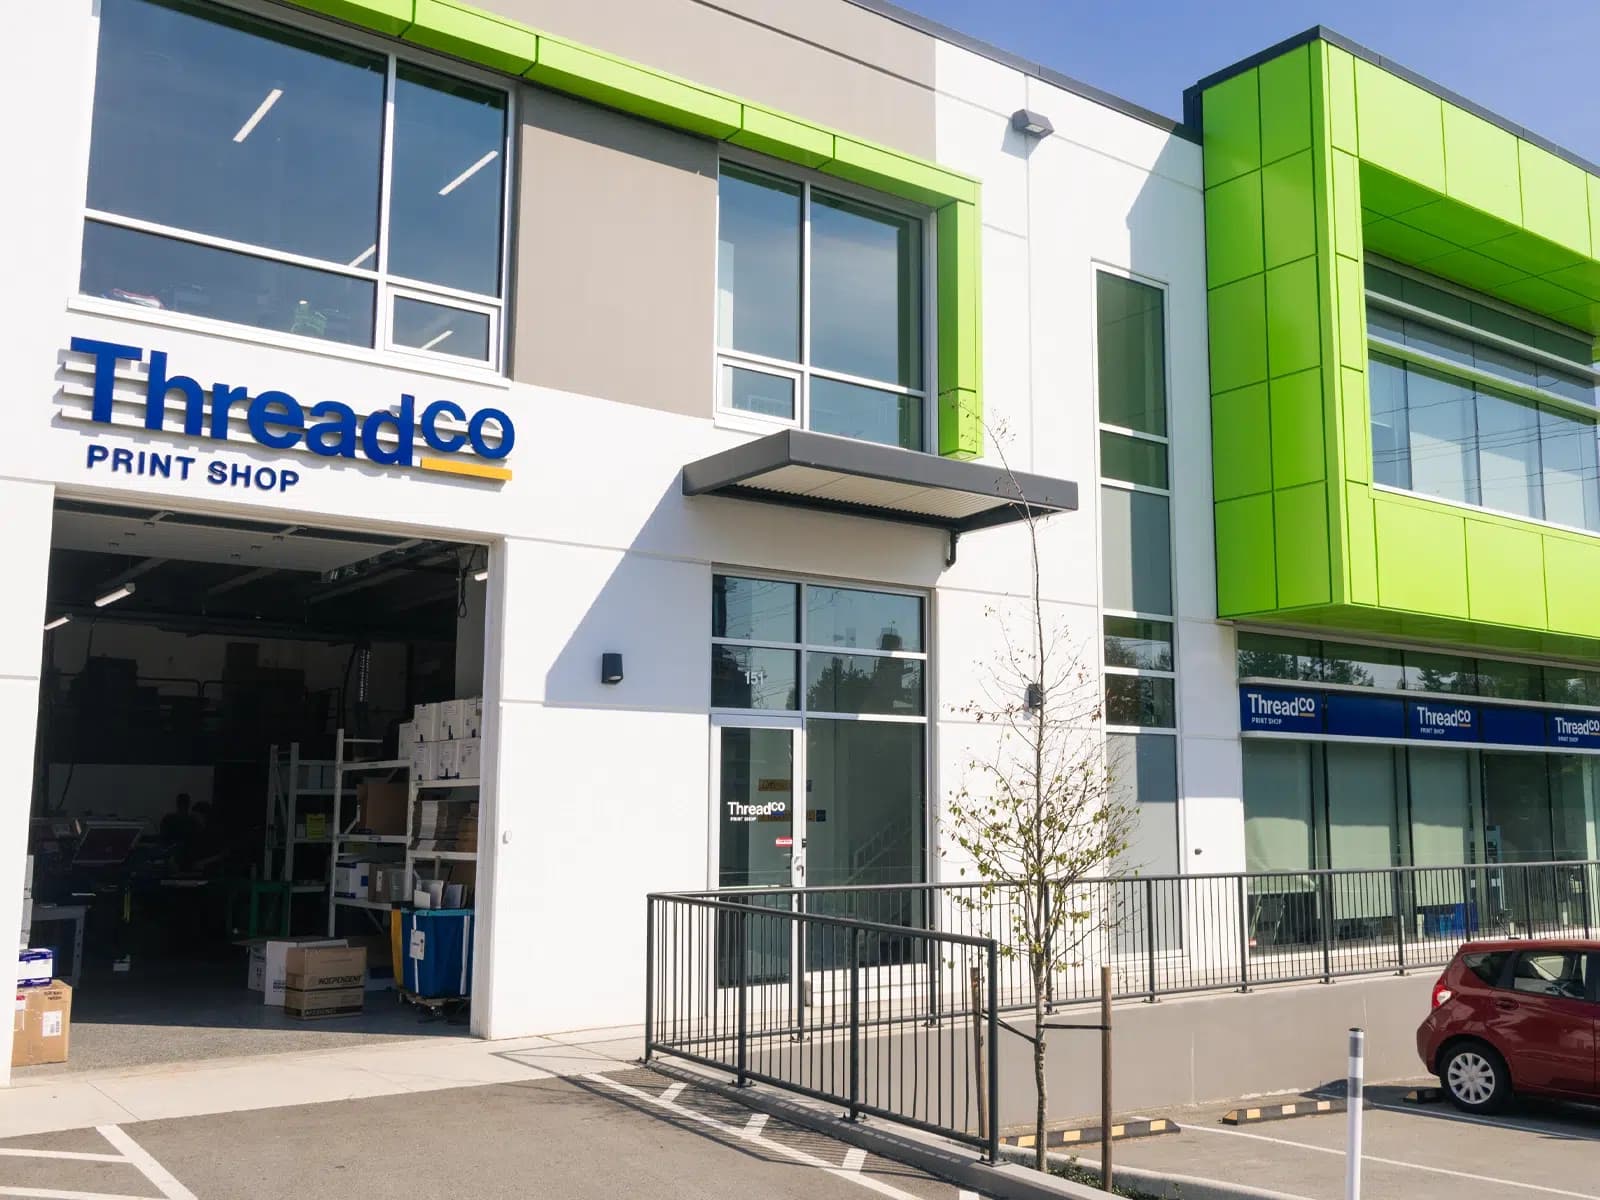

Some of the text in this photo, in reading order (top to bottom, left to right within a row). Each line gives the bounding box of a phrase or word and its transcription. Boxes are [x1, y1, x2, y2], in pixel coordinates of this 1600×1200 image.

[70, 336, 515, 467] Threadco
[87, 445, 299, 492] PRINT SHOP
[744, 671, 764, 685] 151
[1247, 693, 1315, 716] Threadco
[1416, 706, 1471, 727] Threadco
[727, 801, 786, 816] Threadco
